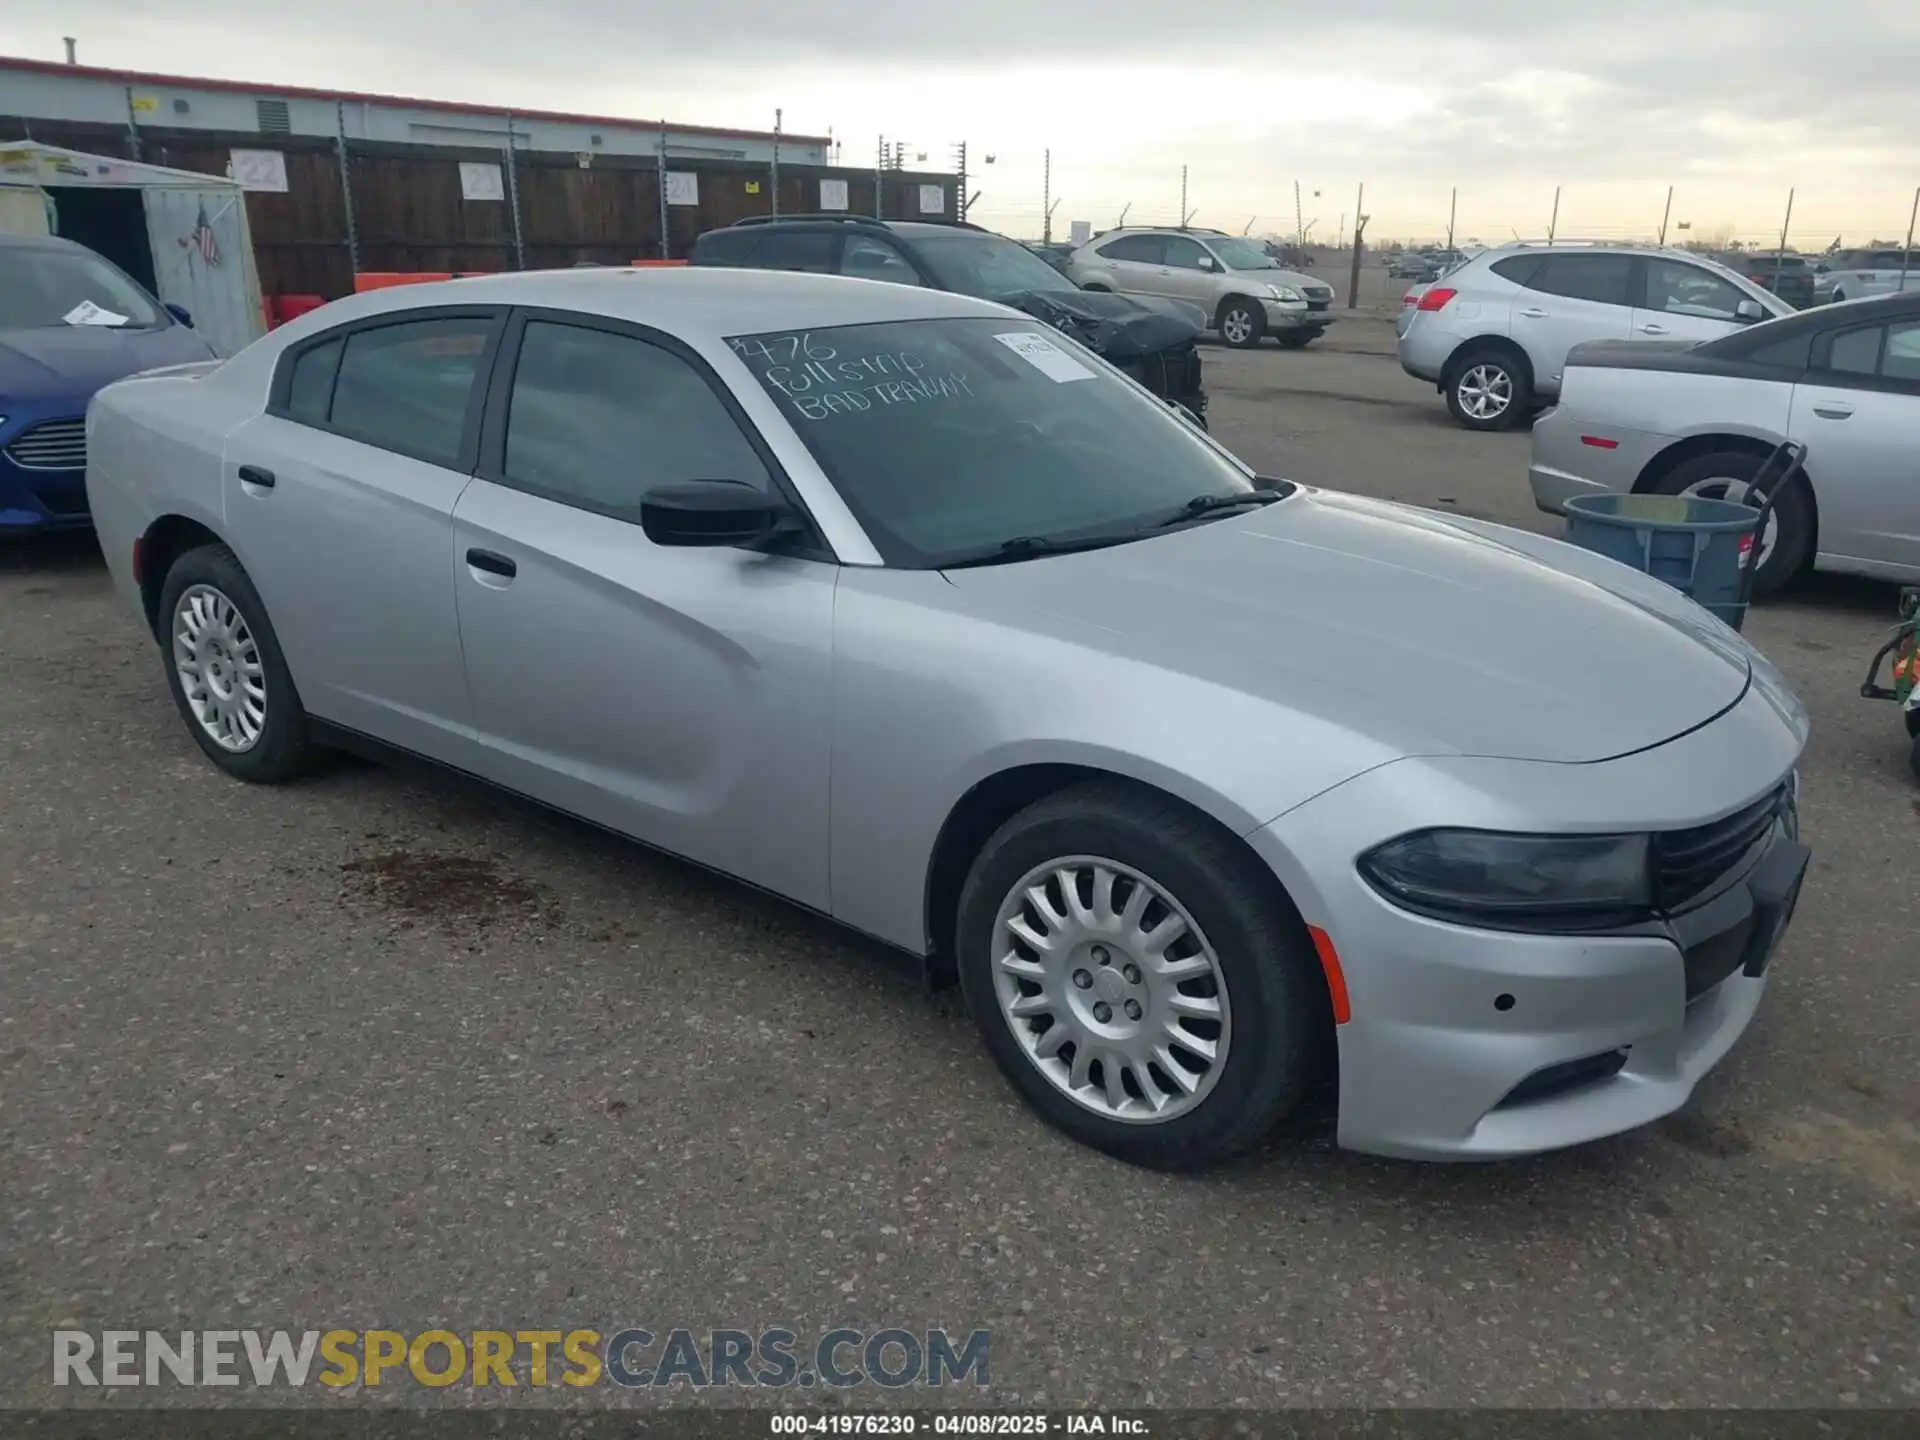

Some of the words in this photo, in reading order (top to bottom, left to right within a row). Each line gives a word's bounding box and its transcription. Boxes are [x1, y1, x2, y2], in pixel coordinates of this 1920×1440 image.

[240, 154, 279, 184] 22
[792, 391, 871, 419] BAD
[864, 373, 974, 404] TRANNY
